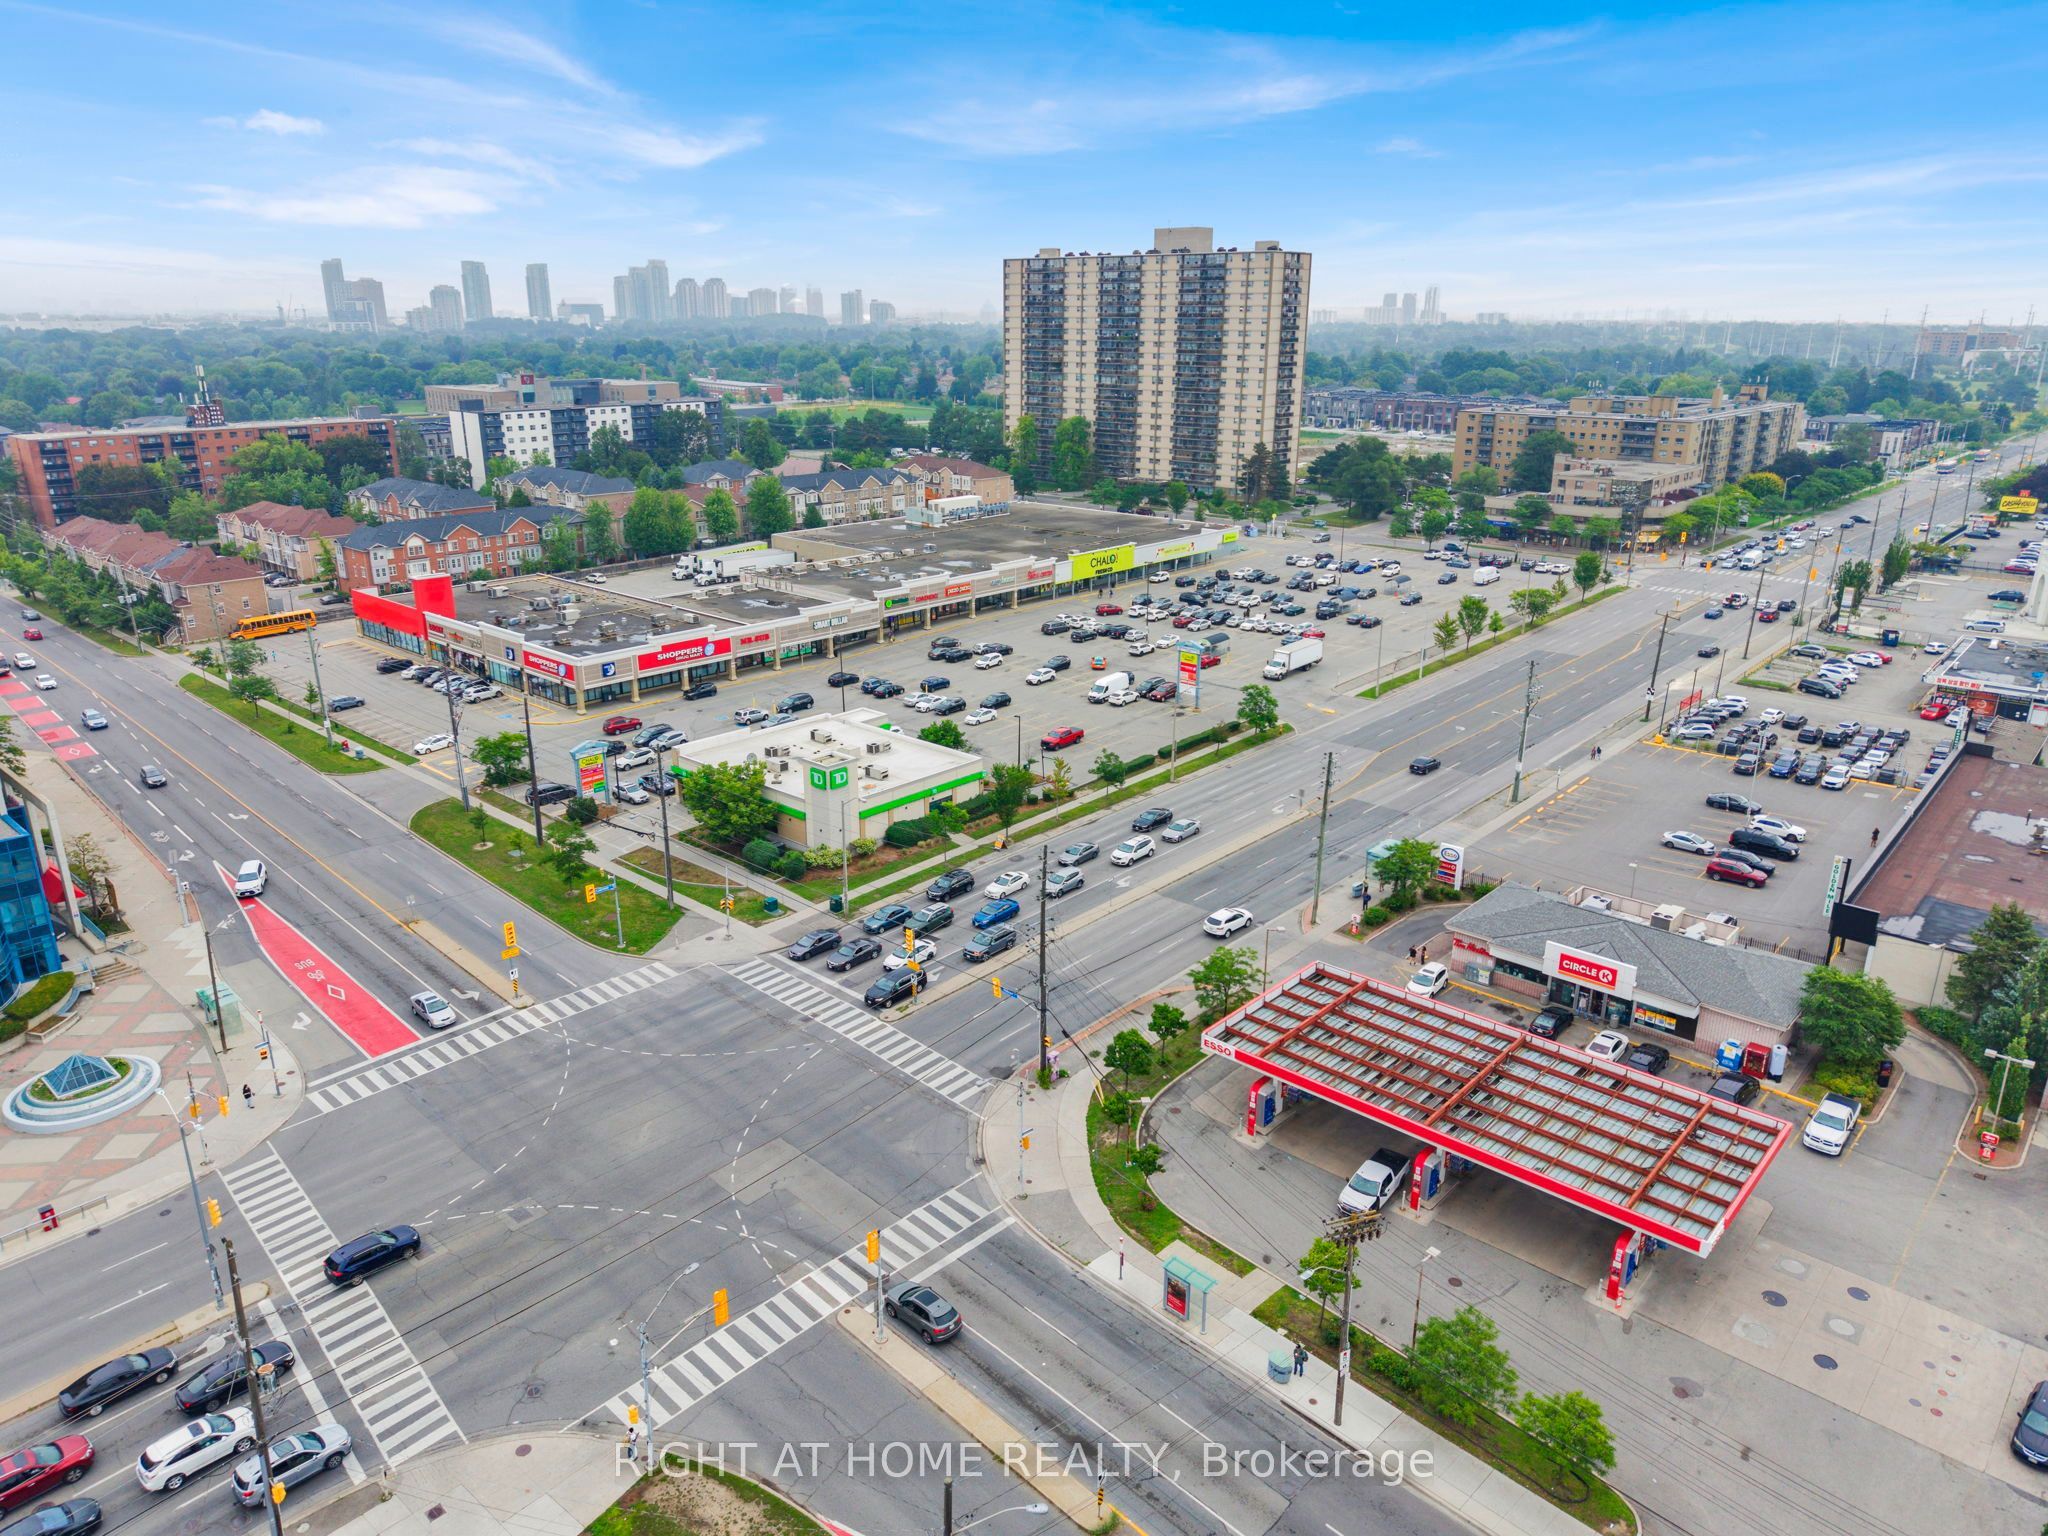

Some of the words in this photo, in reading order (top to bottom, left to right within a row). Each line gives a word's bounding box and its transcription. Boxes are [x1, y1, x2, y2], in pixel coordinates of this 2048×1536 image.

[657, 646, 702, 660] SHOPPERS
[529, 655, 558, 669] SHOPPERS
[811, 771, 823, 785] TD
[834, 771, 846, 785] TD
[294, 959, 315, 969] BUS
[1563, 960, 1597, 976] CIRCLE
[1600, 971, 1611, 982] K
[1203, 1039, 1231, 1056] ESSO
